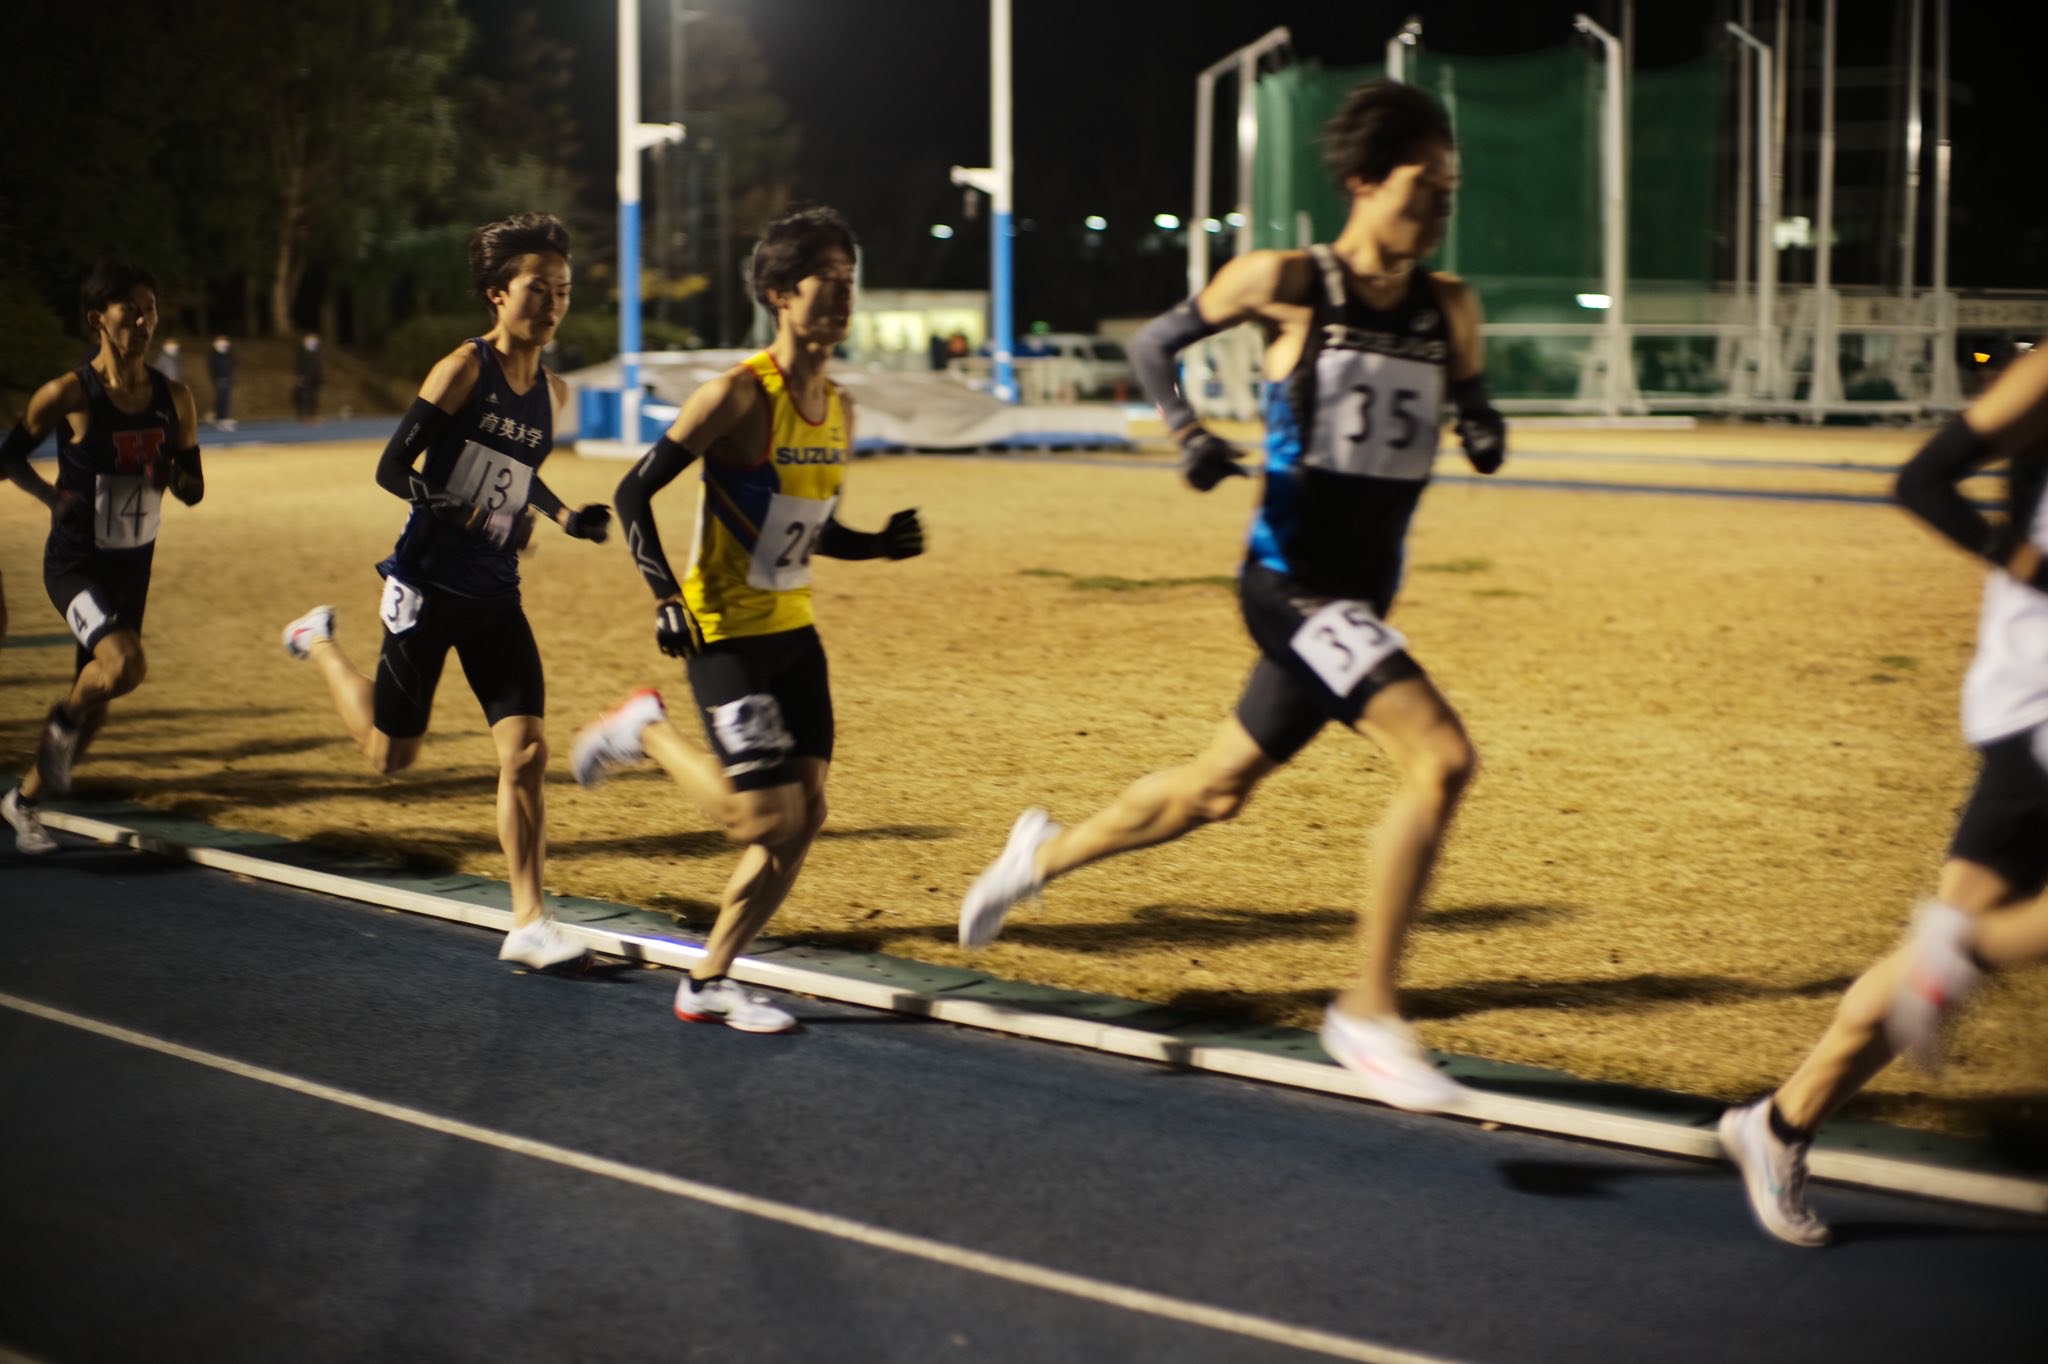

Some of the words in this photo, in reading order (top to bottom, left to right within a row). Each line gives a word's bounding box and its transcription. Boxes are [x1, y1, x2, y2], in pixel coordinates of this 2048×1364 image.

[478, 412, 543, 448] 育英大学
[1347, 383, 1422, 450] 35
[776, 446, 845, 465] SUZU
[105, 482, 149, 538] 14
[471, 461, 513, 511] 13
[72, 605, 89, 633] 4
[1313, 606, 1391, 672] 35
